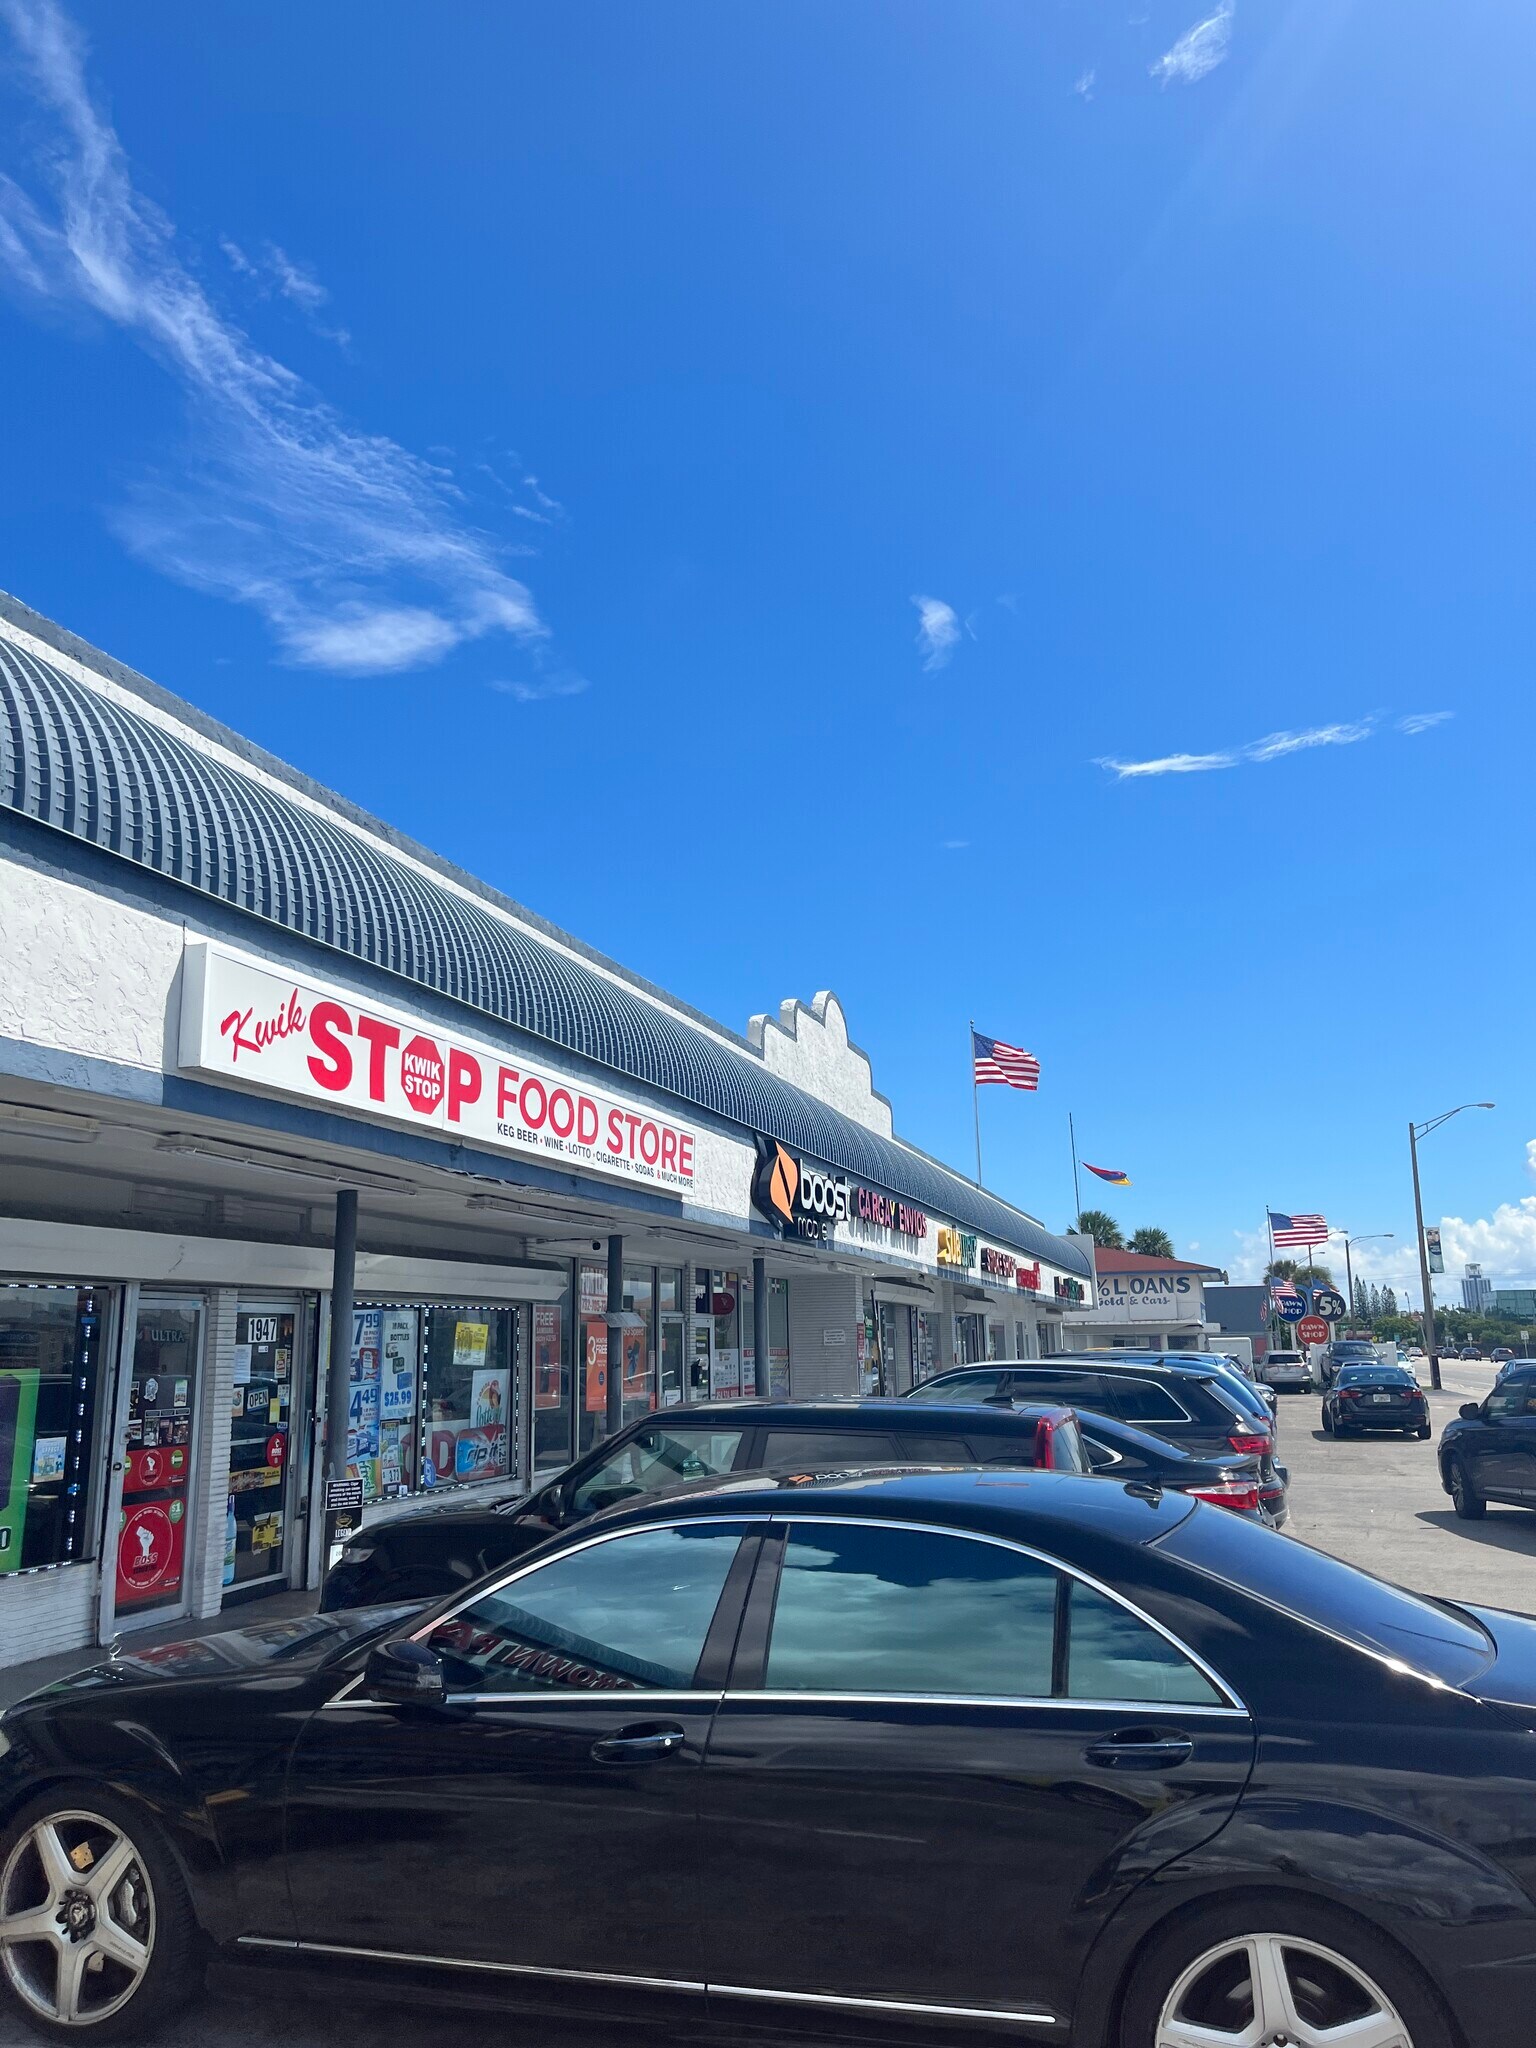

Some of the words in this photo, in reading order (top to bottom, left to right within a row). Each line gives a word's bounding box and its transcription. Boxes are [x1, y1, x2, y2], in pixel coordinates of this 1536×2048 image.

[220, 987, 306, 1063] Kwik
[404, 1053, 441, 1081] KWIK
[404, 1078, 440, 1101] STOP
[497, 1065, 599, 1146] FOOD
[606, 1108, 694, 1178] STORE
[497, 1123, 515, 1138] KEG
[516, 1129, 538, 1145] BEER
[544, 1136, 564, 1151] WINE
[568, 1144, 591, 1159] LOTTO
[596, 1150, 630, 1171] CIGARETTE
[634, 1164, 654, 1178] SODAS
[661, 1172, 678, 1185] MUCH
[678, 1175, 694, 1189] MORE
[800, 1158, 852, 1221] boost
[899, 1203, 928, 1238] ENVIOS
[1113, 1276, 1191, 1295] LOANS
[1129, 1296, 1138, 1305] &
[1141, 1296, 1170, 1305] Cars
[1319, 1296, 1342, 1315] 5%
[249, 1318, 277, 1341] 1947
[535, 1312, 554, 1326] FREE
[151, 1329, 185, 1342] ULTRA
[587, 1335, 597, 1365] 3
[249, 1391, 268, 1408] OPEN
[384, 1389, 412, 1407] $25.99
[466, 1444, 487, 1464] rip
[499, 1433, 507, 1465] $1.25
[134, 1552, 159, 1567] BOSS
